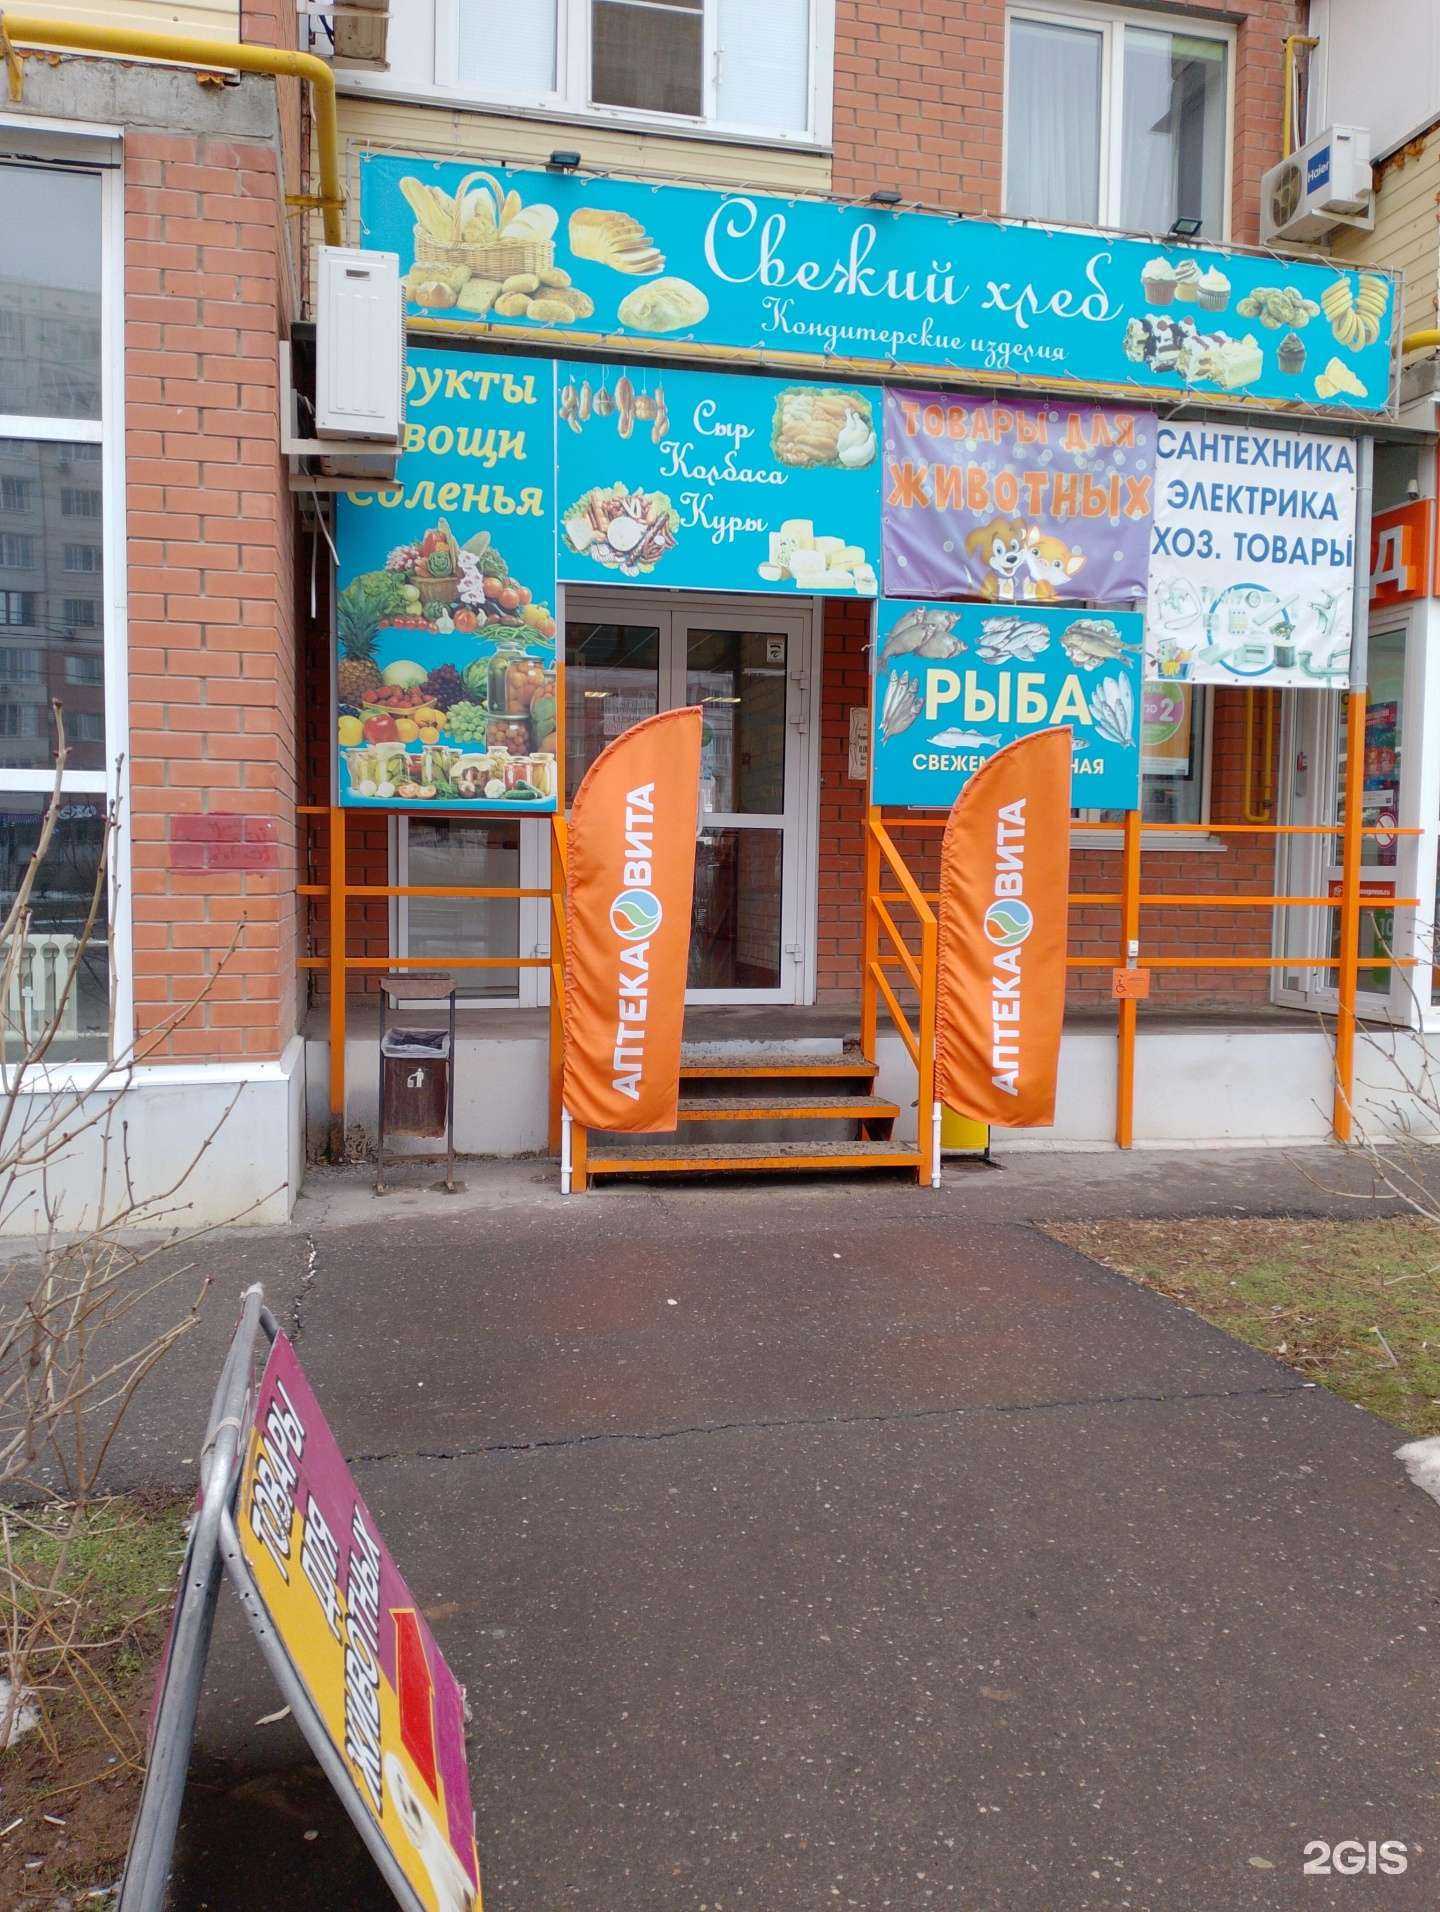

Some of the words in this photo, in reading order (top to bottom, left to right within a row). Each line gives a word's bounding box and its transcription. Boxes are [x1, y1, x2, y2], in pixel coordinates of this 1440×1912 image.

[704, 197, 970, 305] Свежий
[981, 253, 1124, 329] хлеб
[762, 295, 964, 355] Кондитерские
[970, 337, 1070, 368] изделия
[404, 364, 538, 407] укты
[404, 423, 527, 468] вощи
[693, 399, 755, 450] Сыр
[901, 400, 1048, 445] ТОВАРЫ
[1064, 413, 1136, 451] ДЛЯ
[1156, 429, 1355, 474] САНТЕХНИКА
[659, 441, 789, 486] Колбаса
[887, 463, 1152, 518] ЖИВОТНЫХ
[680, 491, 769, 544] Куры
[1166, 479, 1339, 521] ЭЛЕКТРИКА
[1151, 526, 1221, 560] ХОЗ.
[1234, 532, 1353, 569] ТОВАРЫ
[925, 668, 1093, 725] РЫБА
[624, 782, 655, 887] ВИТА
[995, 798, 1027, 897] ВИТА
[612, 941, 650, 1101] АПТЕКА
[991, 947, 1022, 1097] АПТЕКА
[250, 1377, 306, 1585] ТОВАРЫ
[302, 1492, 340, 1643] ДЛЯ
[344, 1503, 382, 1814] ЖИВОТНЫХ
